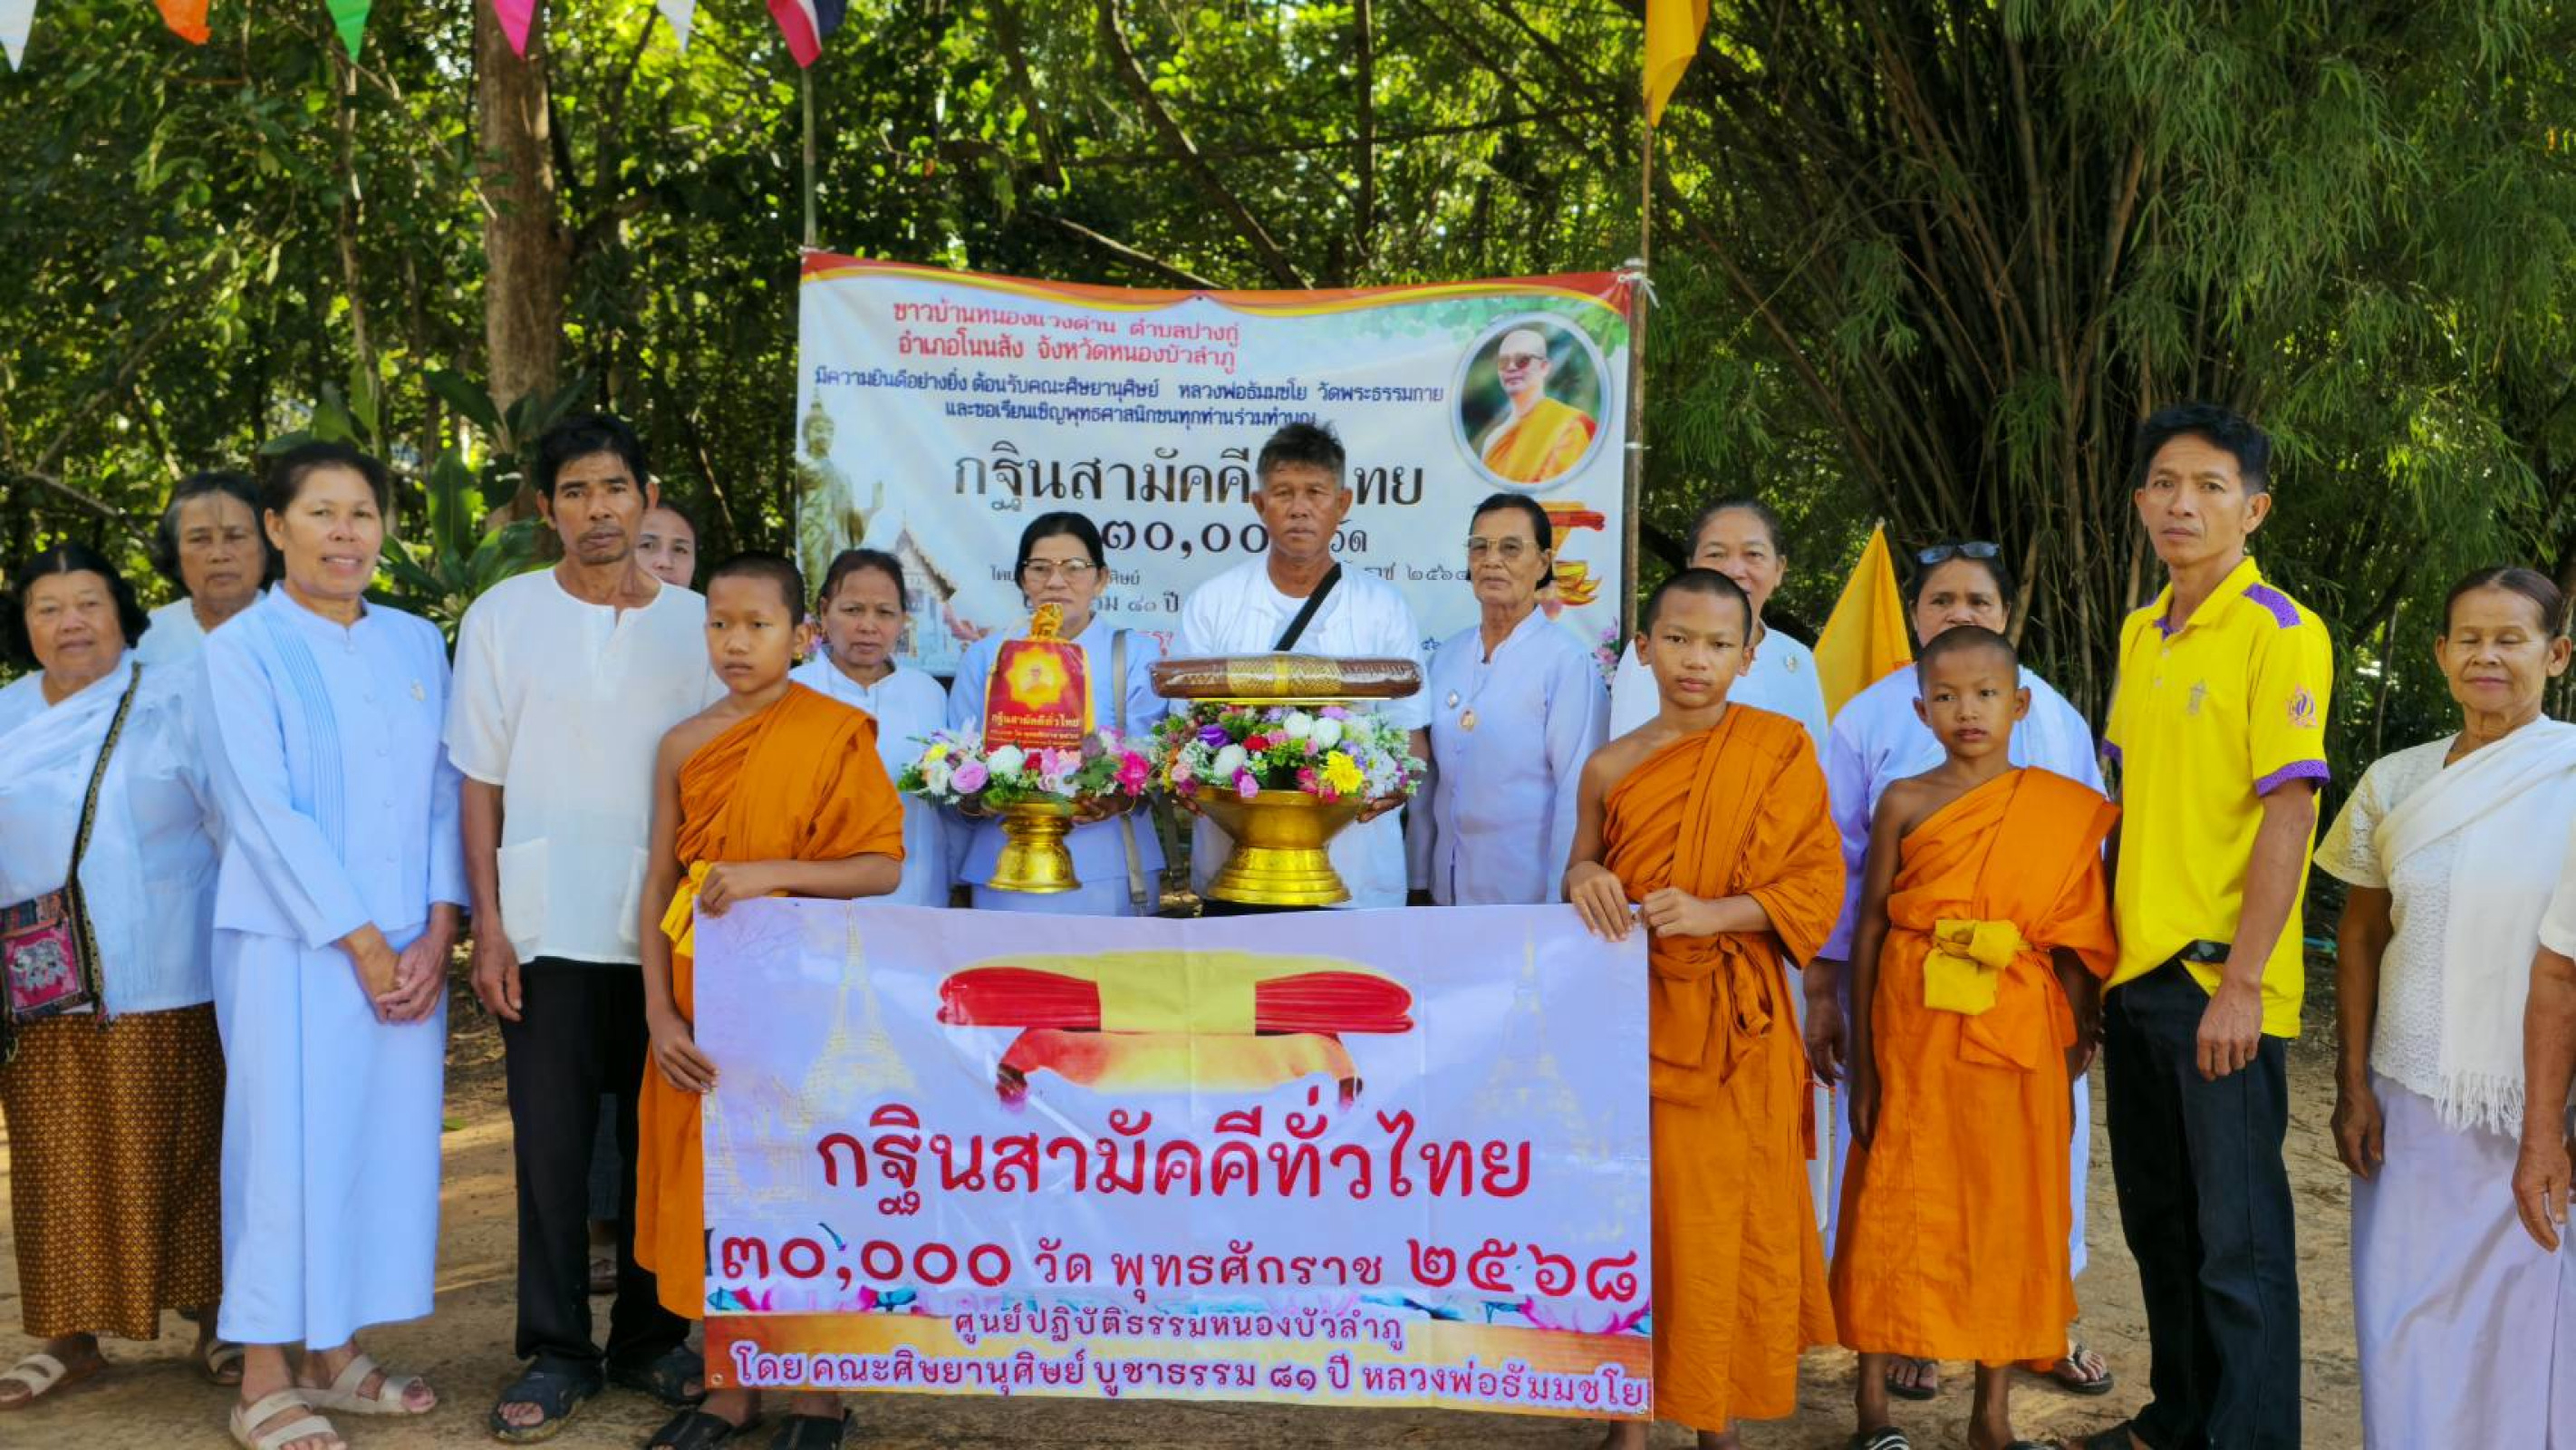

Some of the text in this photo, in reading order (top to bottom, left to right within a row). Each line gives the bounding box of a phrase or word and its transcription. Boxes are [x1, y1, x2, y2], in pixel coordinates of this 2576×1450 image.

[1318, 381, 1444, 402] วัดพระธรรมกาย
[1102, 520, 1269, 559] ๓๐,๐๐
[817, 1085, 1531, 1216] กฐินสามัคคีทั่วไทย
[721, 1236, 1638, 1305] ๓๐,๐๐๐ วัด พุทธศักราช ๒๕๖๘
[955, 1302, 1404, 1351] ศูนย์ปฏิบัติธรรมหนองบัวลำภู
[1095, 1359, 1256, 1398] บูชาธรรม
[1270, 1363, 1317, 1392] ๘๑
[1327, 1351, 1351, 1390] ปี
[1363, 1359, 1645, 1407] หลวงพ่อธัมมชโย
